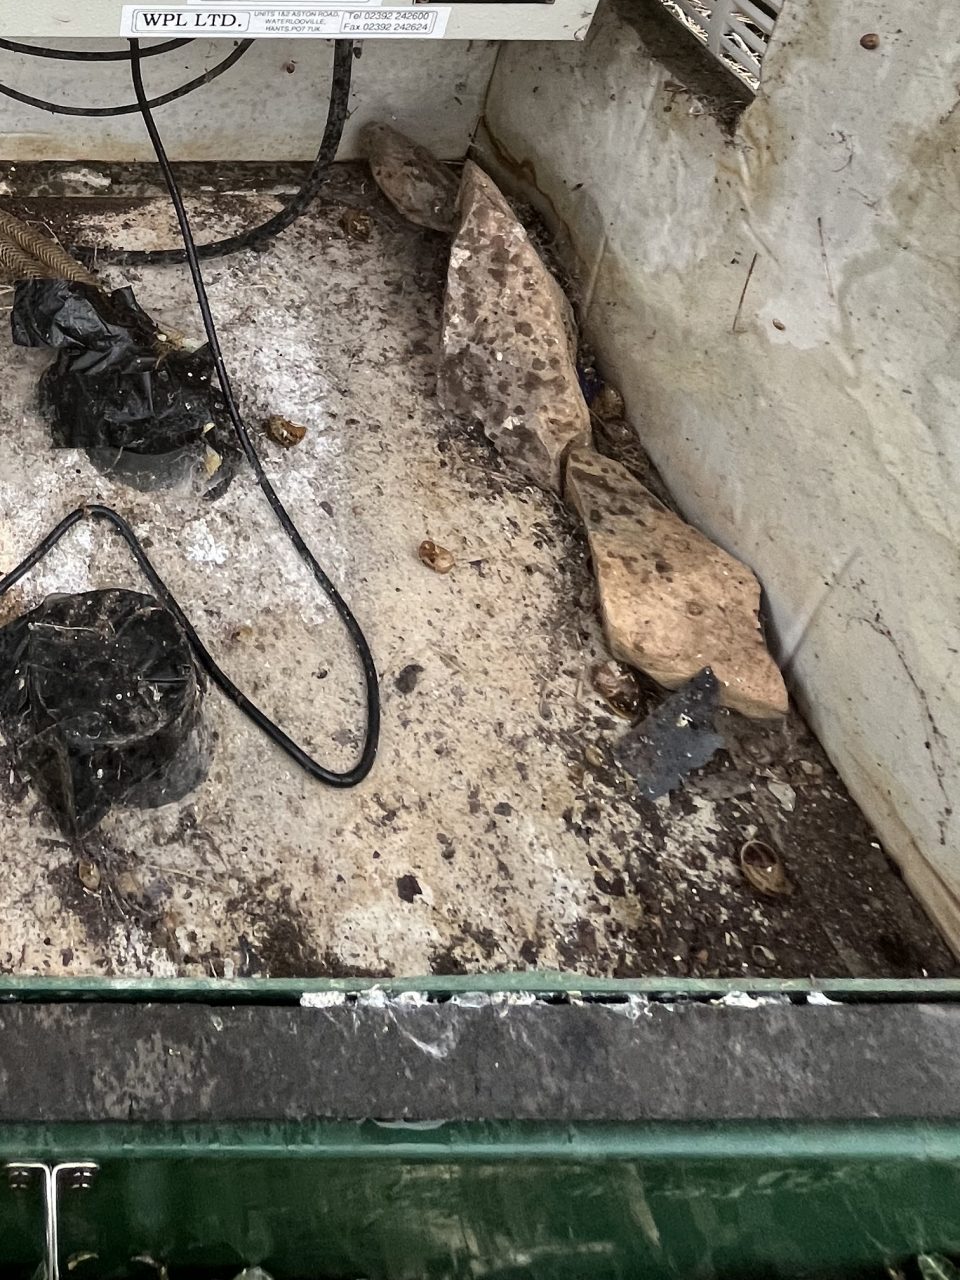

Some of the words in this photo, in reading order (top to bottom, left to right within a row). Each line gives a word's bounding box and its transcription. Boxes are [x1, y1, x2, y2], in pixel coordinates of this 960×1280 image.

[142, 13, 188, 27] WPL
[194, 13, 242, 27] LTD.
[364, 12, 393, 20] 02392
[395, 12, 429, 20] 242600
[343, 23, 360, 31] Fax
[362, 23, 392, 31] 02392
[393, 23, 428, 31] 242624
